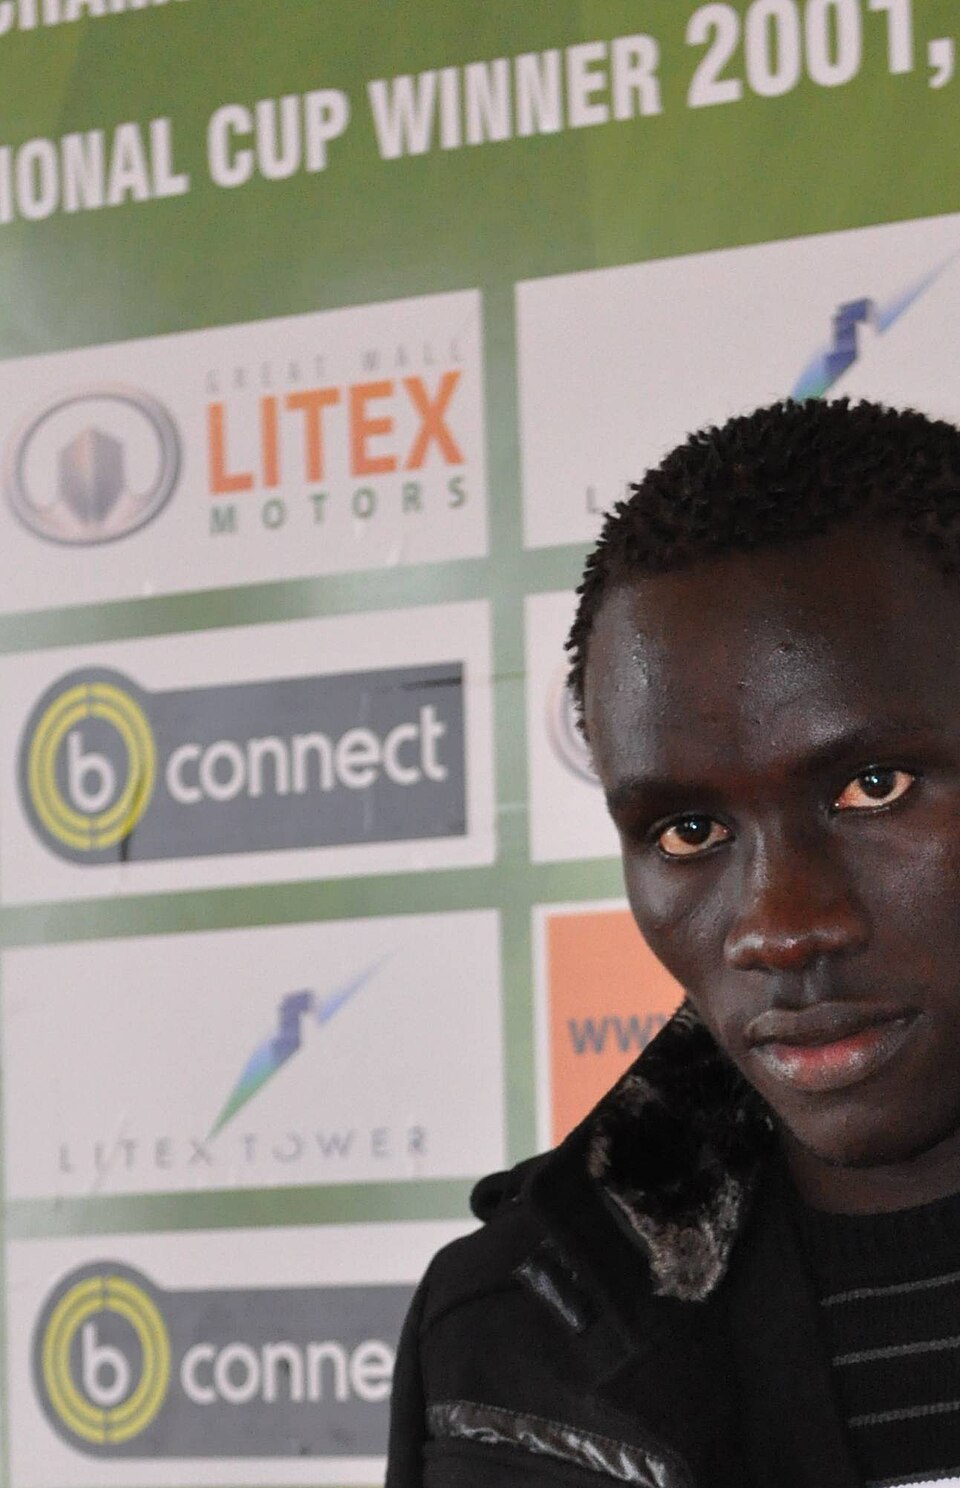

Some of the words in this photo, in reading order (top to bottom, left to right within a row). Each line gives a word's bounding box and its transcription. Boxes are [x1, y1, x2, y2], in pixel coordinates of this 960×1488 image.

[207, 90, 349, 188] CUP
[368, 34, 662, 160] WINNER
[684, 0, 955, 110] 2001,
[207, 369, 465, 496] LITEX
[209, 476, 466, 536] MOTORS
[165, 704, 447, 804] connect
